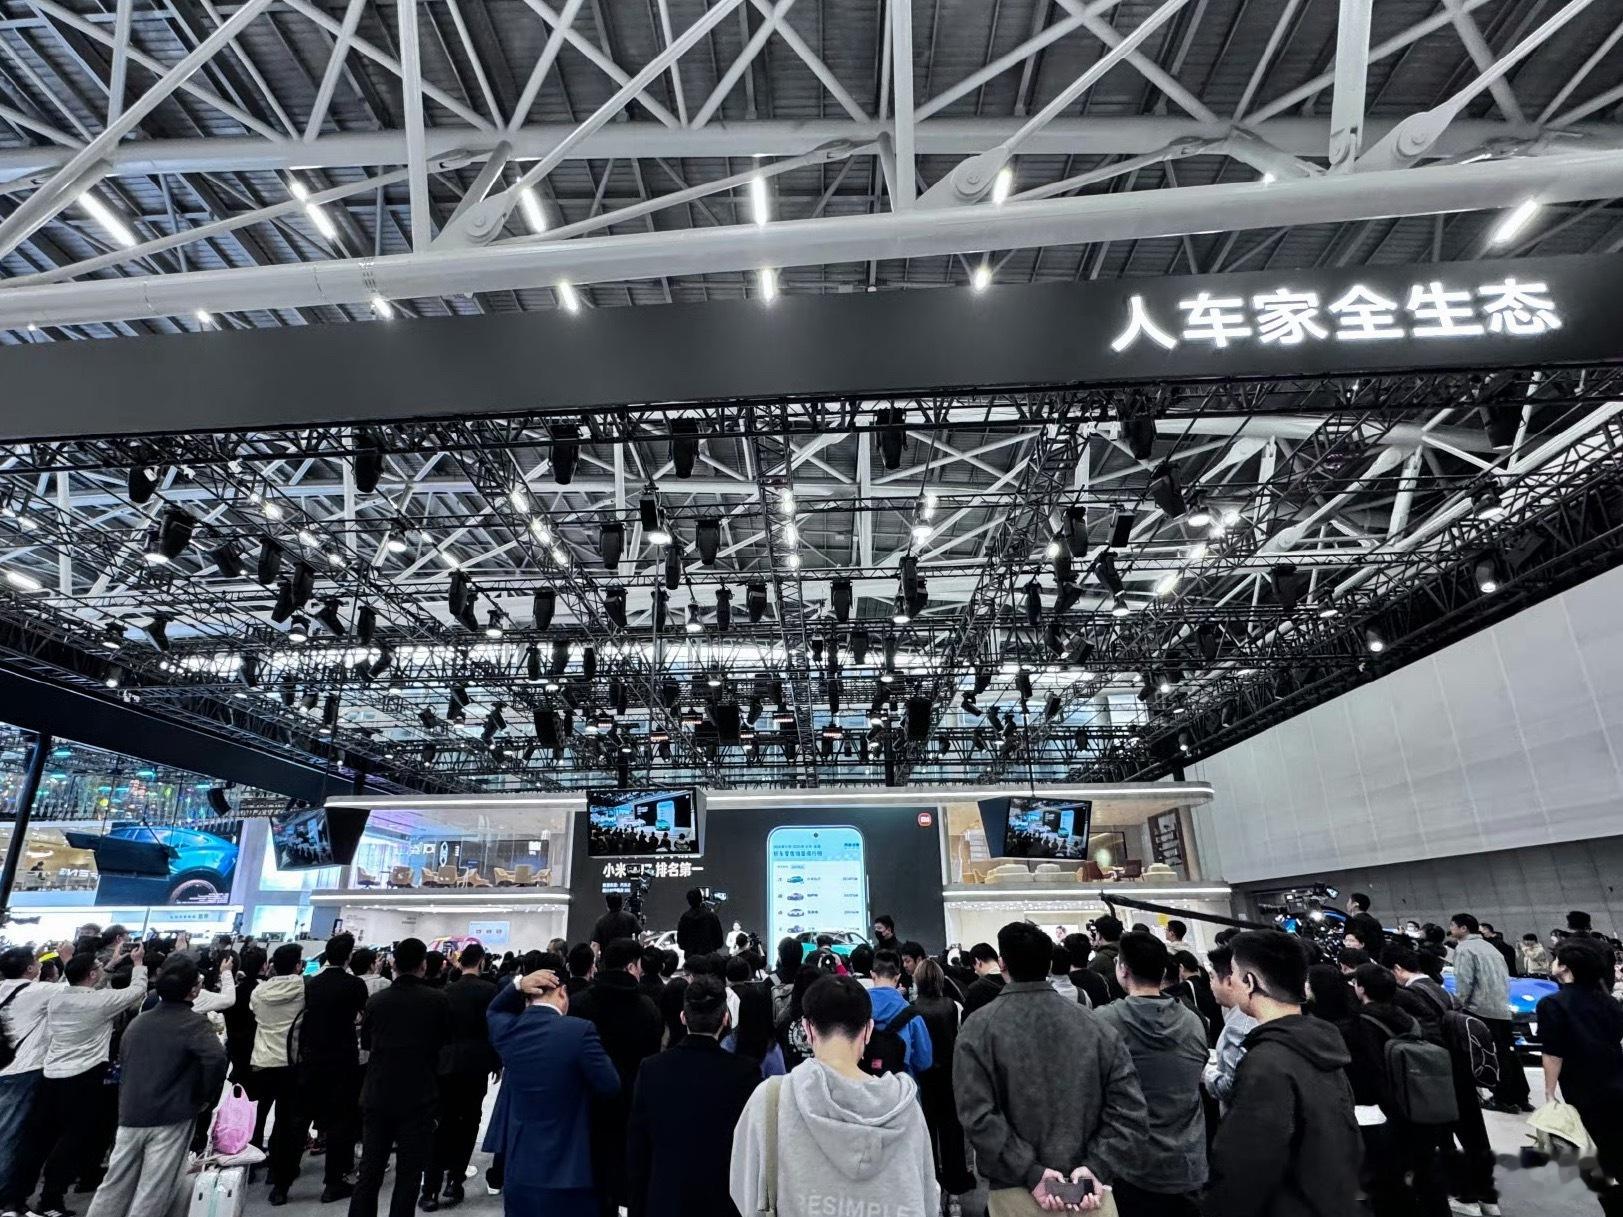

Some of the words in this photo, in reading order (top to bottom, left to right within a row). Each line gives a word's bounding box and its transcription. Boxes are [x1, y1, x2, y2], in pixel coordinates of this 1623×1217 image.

[1112, 278, 1561, 351] 人车家全生态
[655, 862, 704, 878] 排名第一
